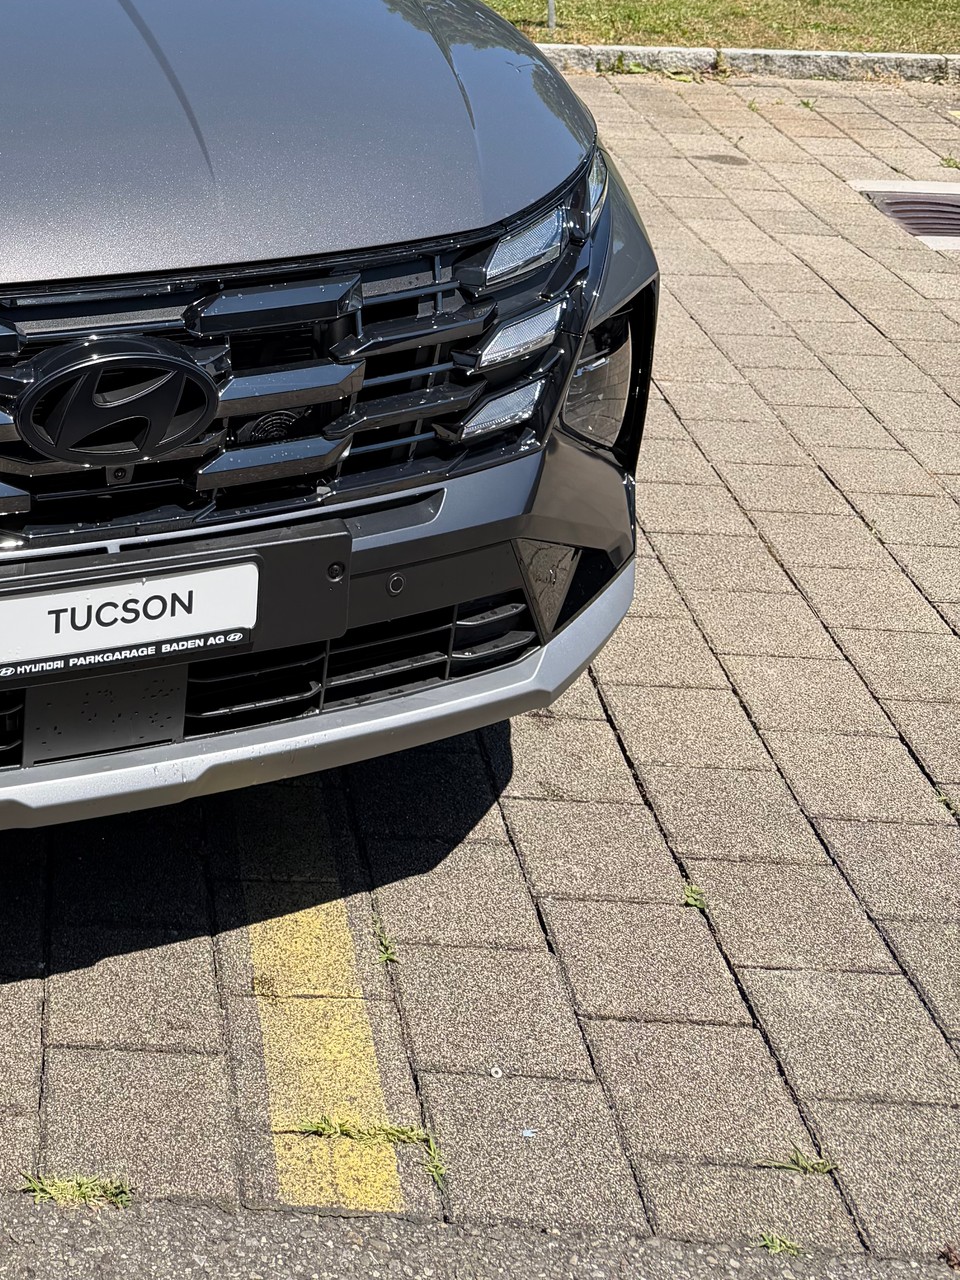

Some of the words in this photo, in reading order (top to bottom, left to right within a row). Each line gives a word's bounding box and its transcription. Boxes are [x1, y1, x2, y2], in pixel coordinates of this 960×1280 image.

[48, 590, 194, 634] TUCSON
[17, 660, 64, 674] HYUNDAI
[69, 646, 156, 666] PARKGARAGE
[161, 638, 205, 653] BADEN
[207, 635, 225, 646] AG
